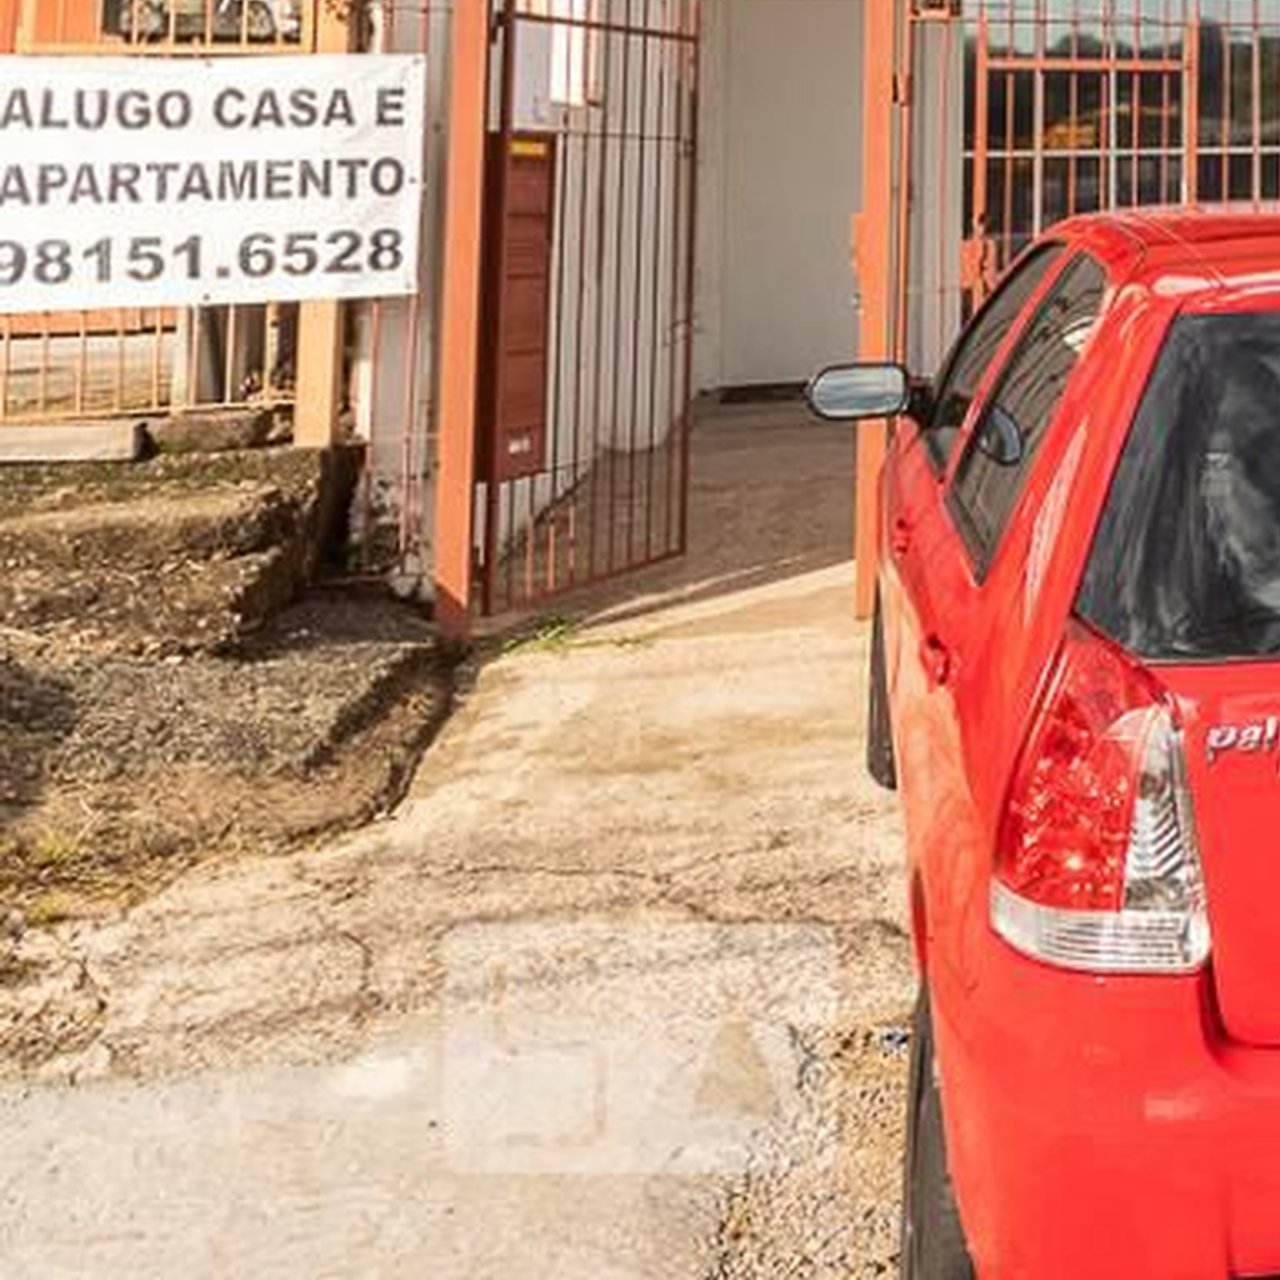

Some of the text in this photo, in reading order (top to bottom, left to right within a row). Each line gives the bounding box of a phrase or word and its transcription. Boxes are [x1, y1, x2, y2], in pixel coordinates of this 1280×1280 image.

[2, 86, 405, 130] ALUGO CASA E
[0, 157, 405, 206] APARTAMENTO
